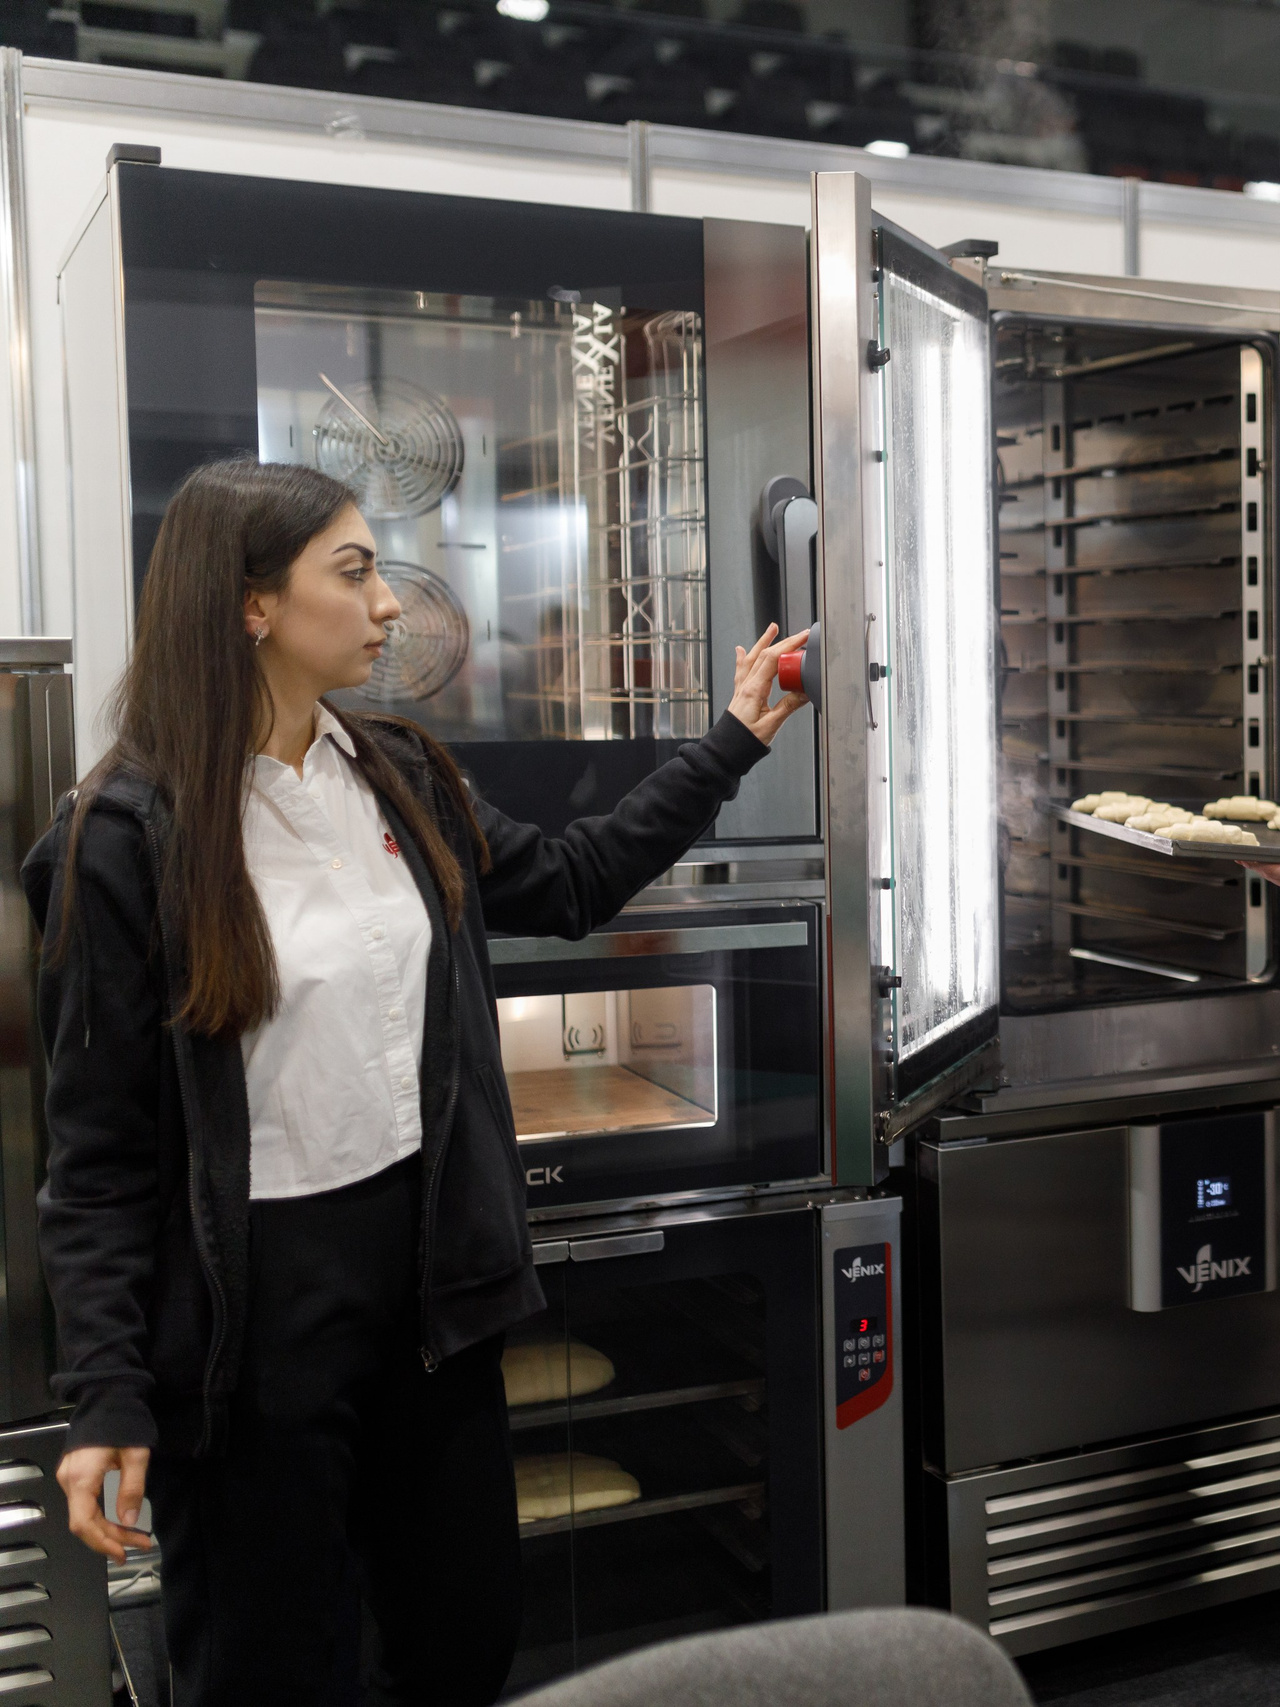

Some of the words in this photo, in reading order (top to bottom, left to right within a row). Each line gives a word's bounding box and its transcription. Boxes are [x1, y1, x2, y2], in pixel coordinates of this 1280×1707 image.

[525, 1165, 564, 1186] CK
[841, 1258, 884, 1282] VENIX
[1176, 1247, 1252, 1291] VENIX
[859, 1319, 868, 1332] 3
